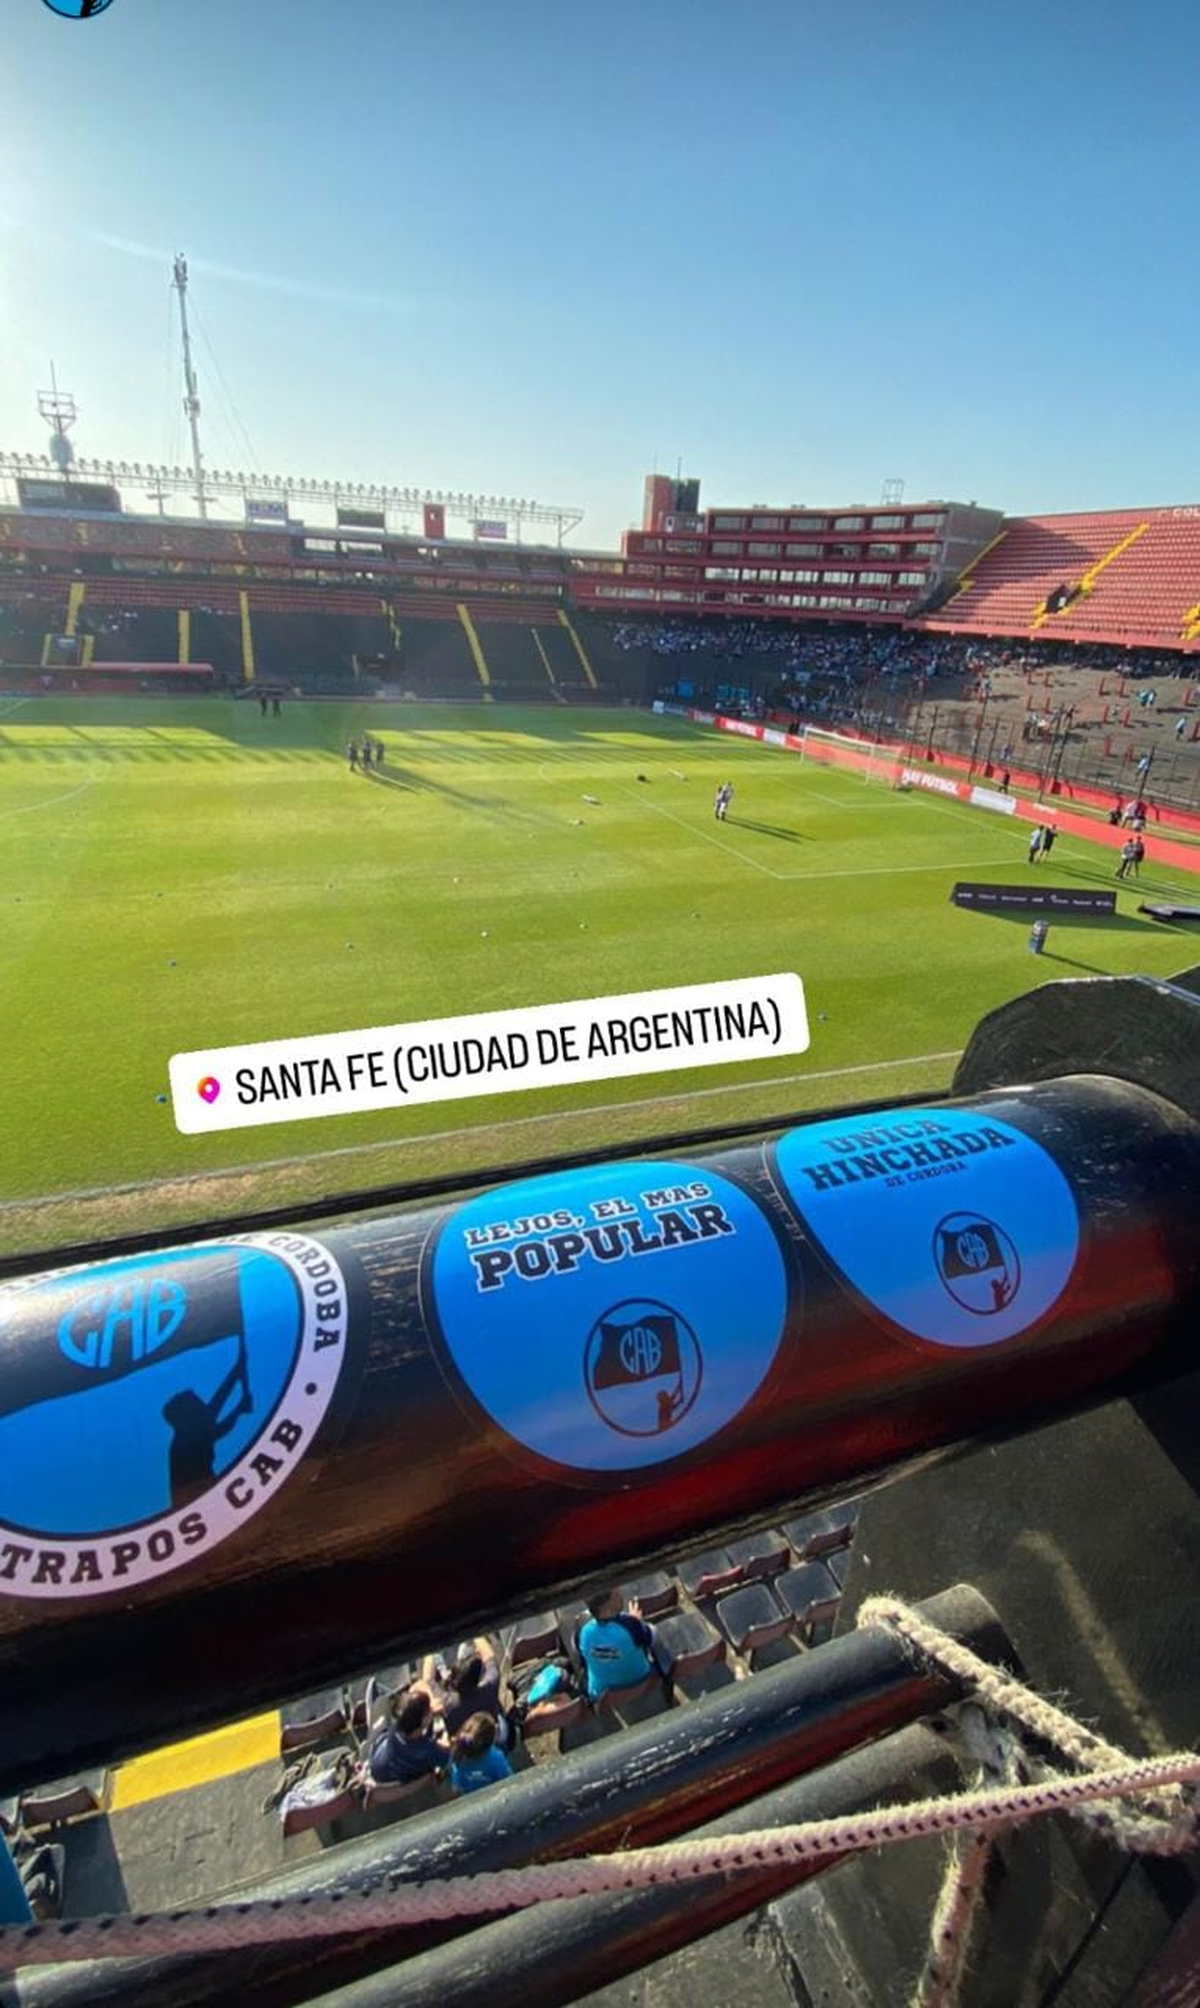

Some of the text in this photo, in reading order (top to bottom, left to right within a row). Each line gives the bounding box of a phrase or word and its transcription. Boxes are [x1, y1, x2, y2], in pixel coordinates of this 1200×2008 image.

[802, 1126, 1016, 1191] HINCHADA
[466, 1182, 710, 1246] LEJOS, EL MAS
[472, 1204, 736, 1293] POPULAR
[57, 1278, 189, 1369] CAB
[268, 1236, 341, 1352] CORDOBA
[619, 1326, 663, 1376] CAB
[1, 1418, 303, 1584] TRAPOS CAB
